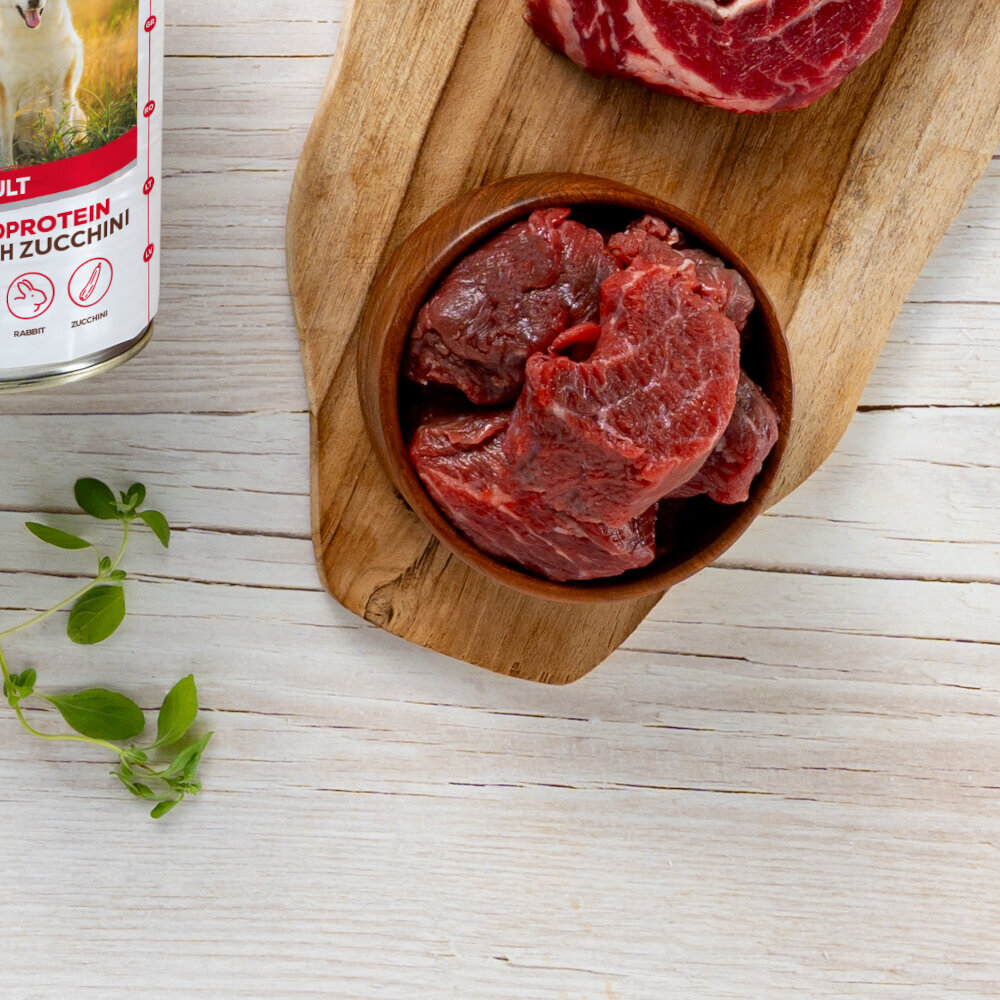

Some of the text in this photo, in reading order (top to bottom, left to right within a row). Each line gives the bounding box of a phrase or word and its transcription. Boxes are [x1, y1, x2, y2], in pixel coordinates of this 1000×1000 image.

[145, 17, 155, 28] GR
[144, 102, 154, 114] RO
[19, 207, 130, 259] ZUCCHINI
[70, 310, 109, 329] ZUCCHINI
[13, 326, 46, 338] RABBIT
